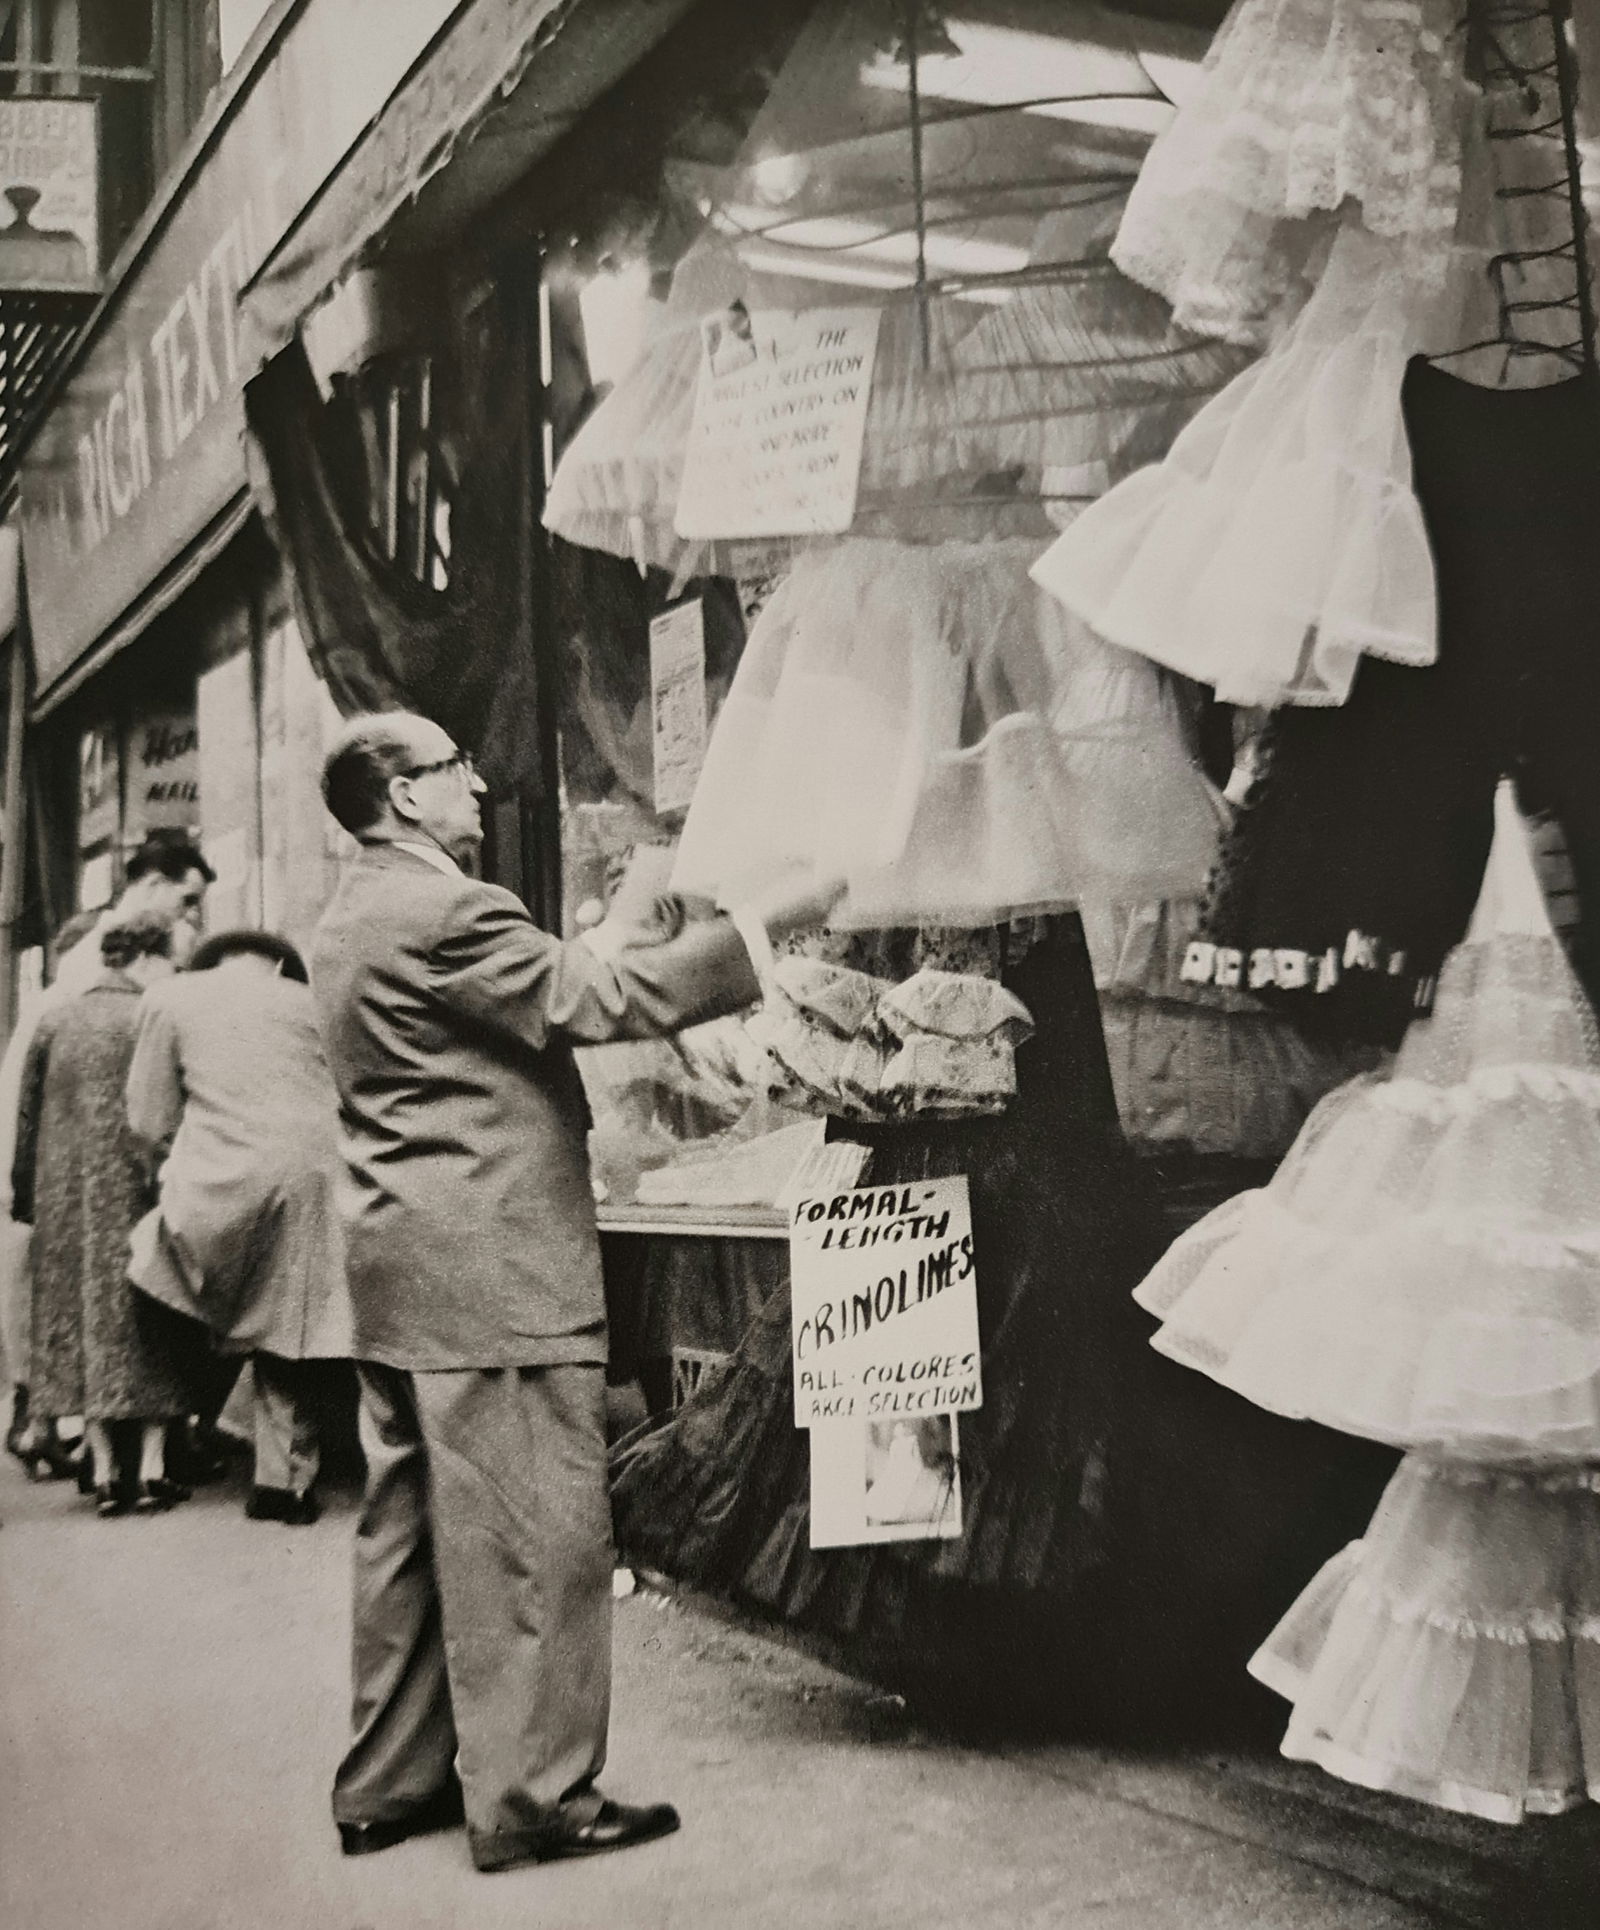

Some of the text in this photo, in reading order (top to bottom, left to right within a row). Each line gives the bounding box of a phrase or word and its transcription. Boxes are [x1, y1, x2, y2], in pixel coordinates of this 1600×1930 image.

[816, 328, 848, 350] THE
[794, 1187, 937, 1225] FORMAL-
[821, 1210, 950, 1250] LENGTH
[797, 1233, 975, 1361] CRINOLINES
[867, 1382, 977, 1416] SELECTION
